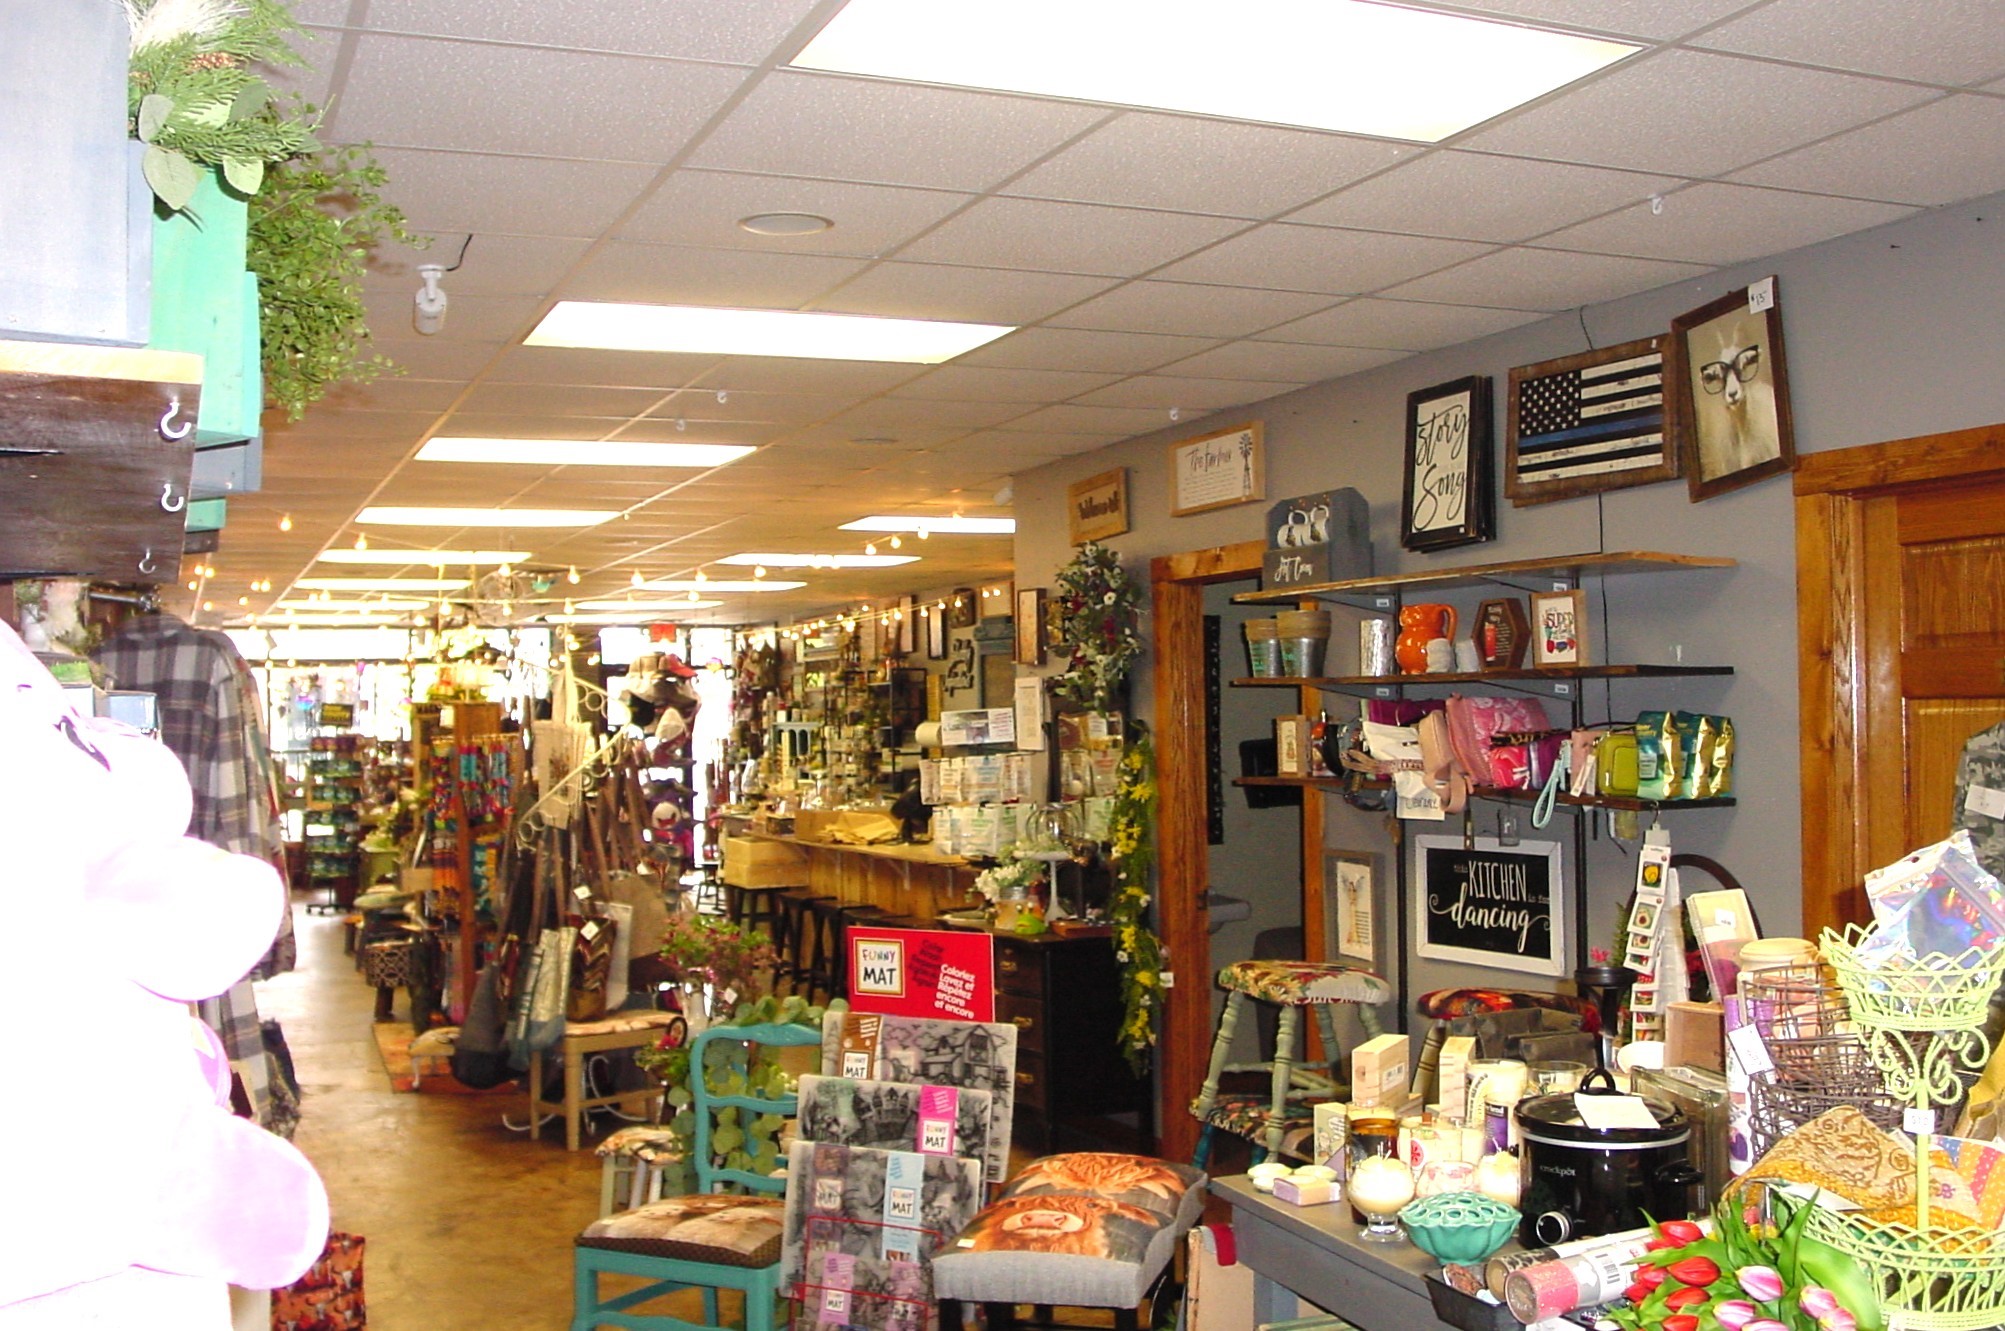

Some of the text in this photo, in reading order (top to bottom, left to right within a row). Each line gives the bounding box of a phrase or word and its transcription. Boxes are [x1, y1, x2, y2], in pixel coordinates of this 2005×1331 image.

[1468, 860, 1527, 902] KITCHEN
[1444, 882, 1536, 953] dancing
[862, 948, 896, 963] FUNNY
[862, 967, 896, 986] MAT
[845, 1066, 866, 1078] MAT
[925, 1135, 946, 1148] MAT
[891, 1201, 913, 1215] MAT
